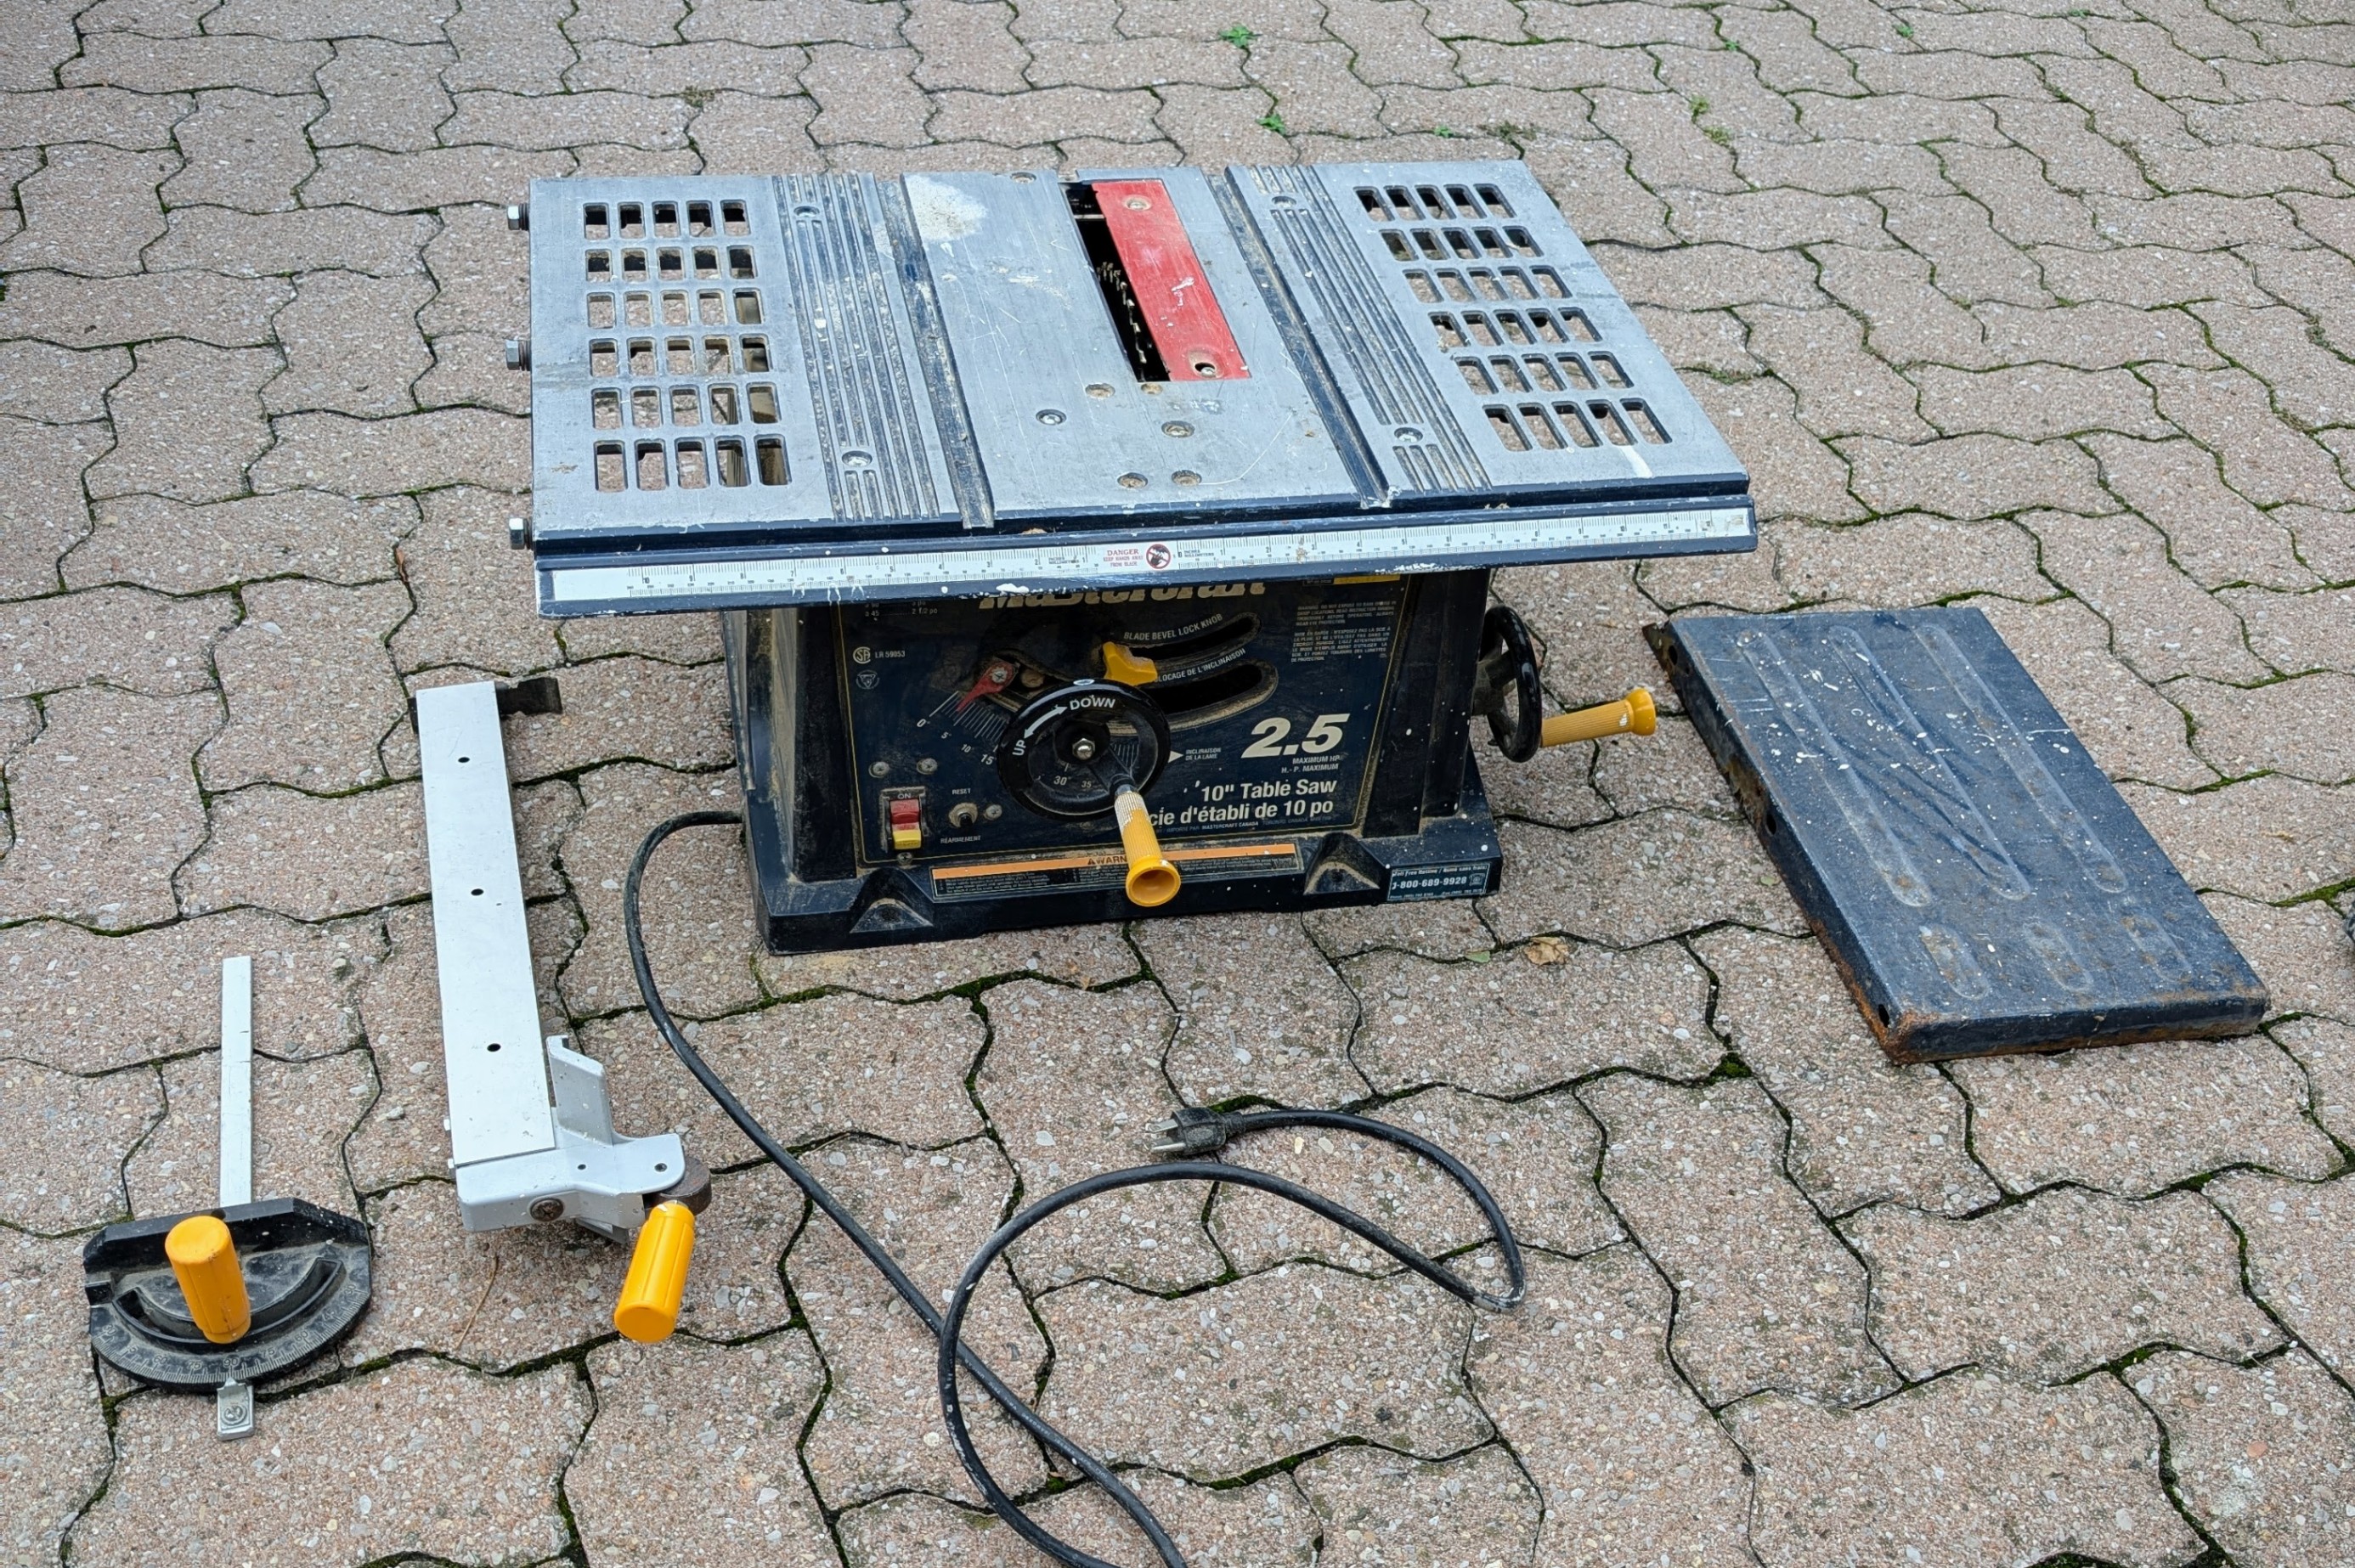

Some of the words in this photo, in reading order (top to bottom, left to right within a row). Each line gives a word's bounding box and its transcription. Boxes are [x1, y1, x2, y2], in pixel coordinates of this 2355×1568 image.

[1123, 631, 1150, 640] BLADE
[1152, 630, 1177, 640] BEVEL
[1178, 624, 1200, 636] LOCK
[1201, 613, 1223, 629] KNOB
[1198, 648, 1246, 675] L'INCLINAISON
[1070, 697, 1115, 710] DOWN
[1240, 713, 1350, 759] 2.5
[1013, 739, 1026, 756] UP
[1292, 756, 1328, 764] MAXIMUM
[1302, 763, 1339, 772] MAXIMUM
[1201, 784, 1234, 802] 10"
[1240, 781, 1290, 799] Table
[1296, 779, 1337, 796] Saw
[1148, 807, 1174, 826] cie
[1180, 804, 1249, 824] d'établi
[1255, 803, 1278, 818] de
[1284, 800, 1306, 816] 10
[1310, 800, 1333, 818] po
[1392, 876, 1467, 890] 1-800-689-9928
[154, 1355, 168, 1364] 60
[188, 1361, 202, 1370] 75
[223, 1356, 239, 1368] 90
